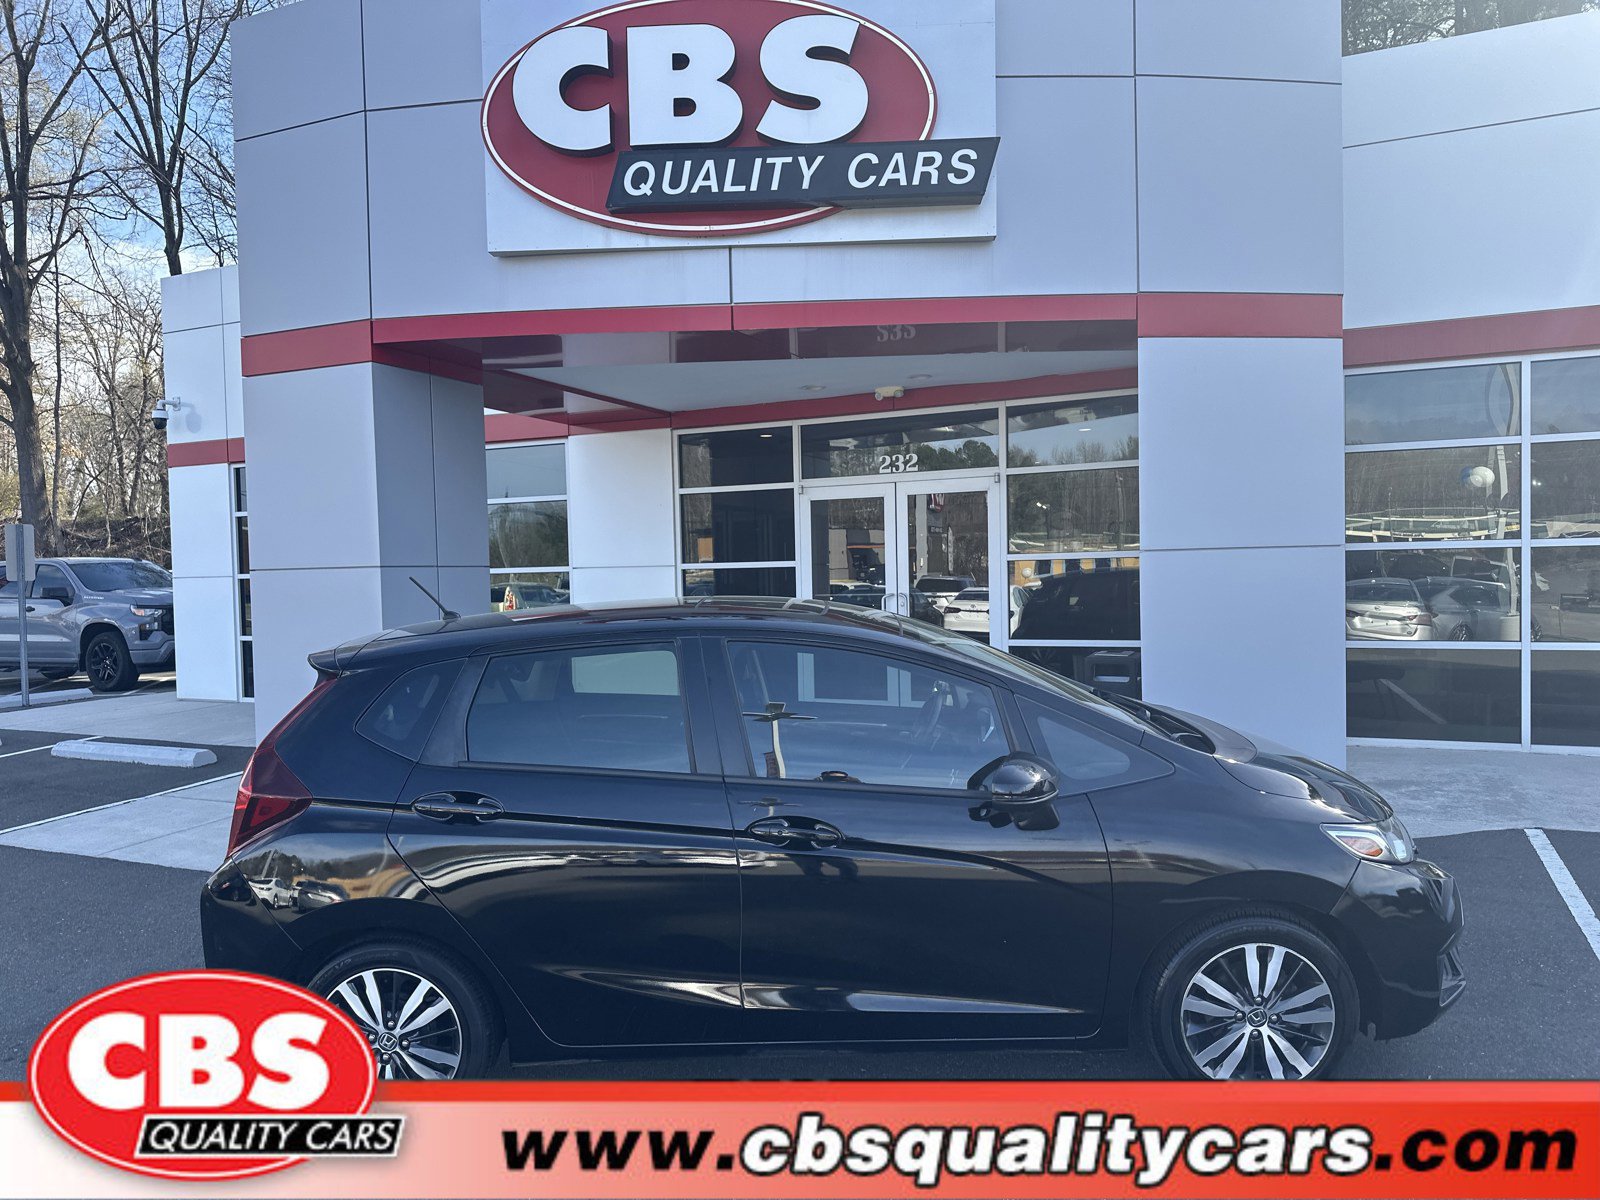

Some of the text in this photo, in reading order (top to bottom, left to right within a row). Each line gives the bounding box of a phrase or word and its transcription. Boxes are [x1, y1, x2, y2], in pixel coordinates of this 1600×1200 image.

[511, 14, 869, 153] CBS
[622, 148, 979, 197] QUALITY CARS
[878, 453, 919, 474] 232
